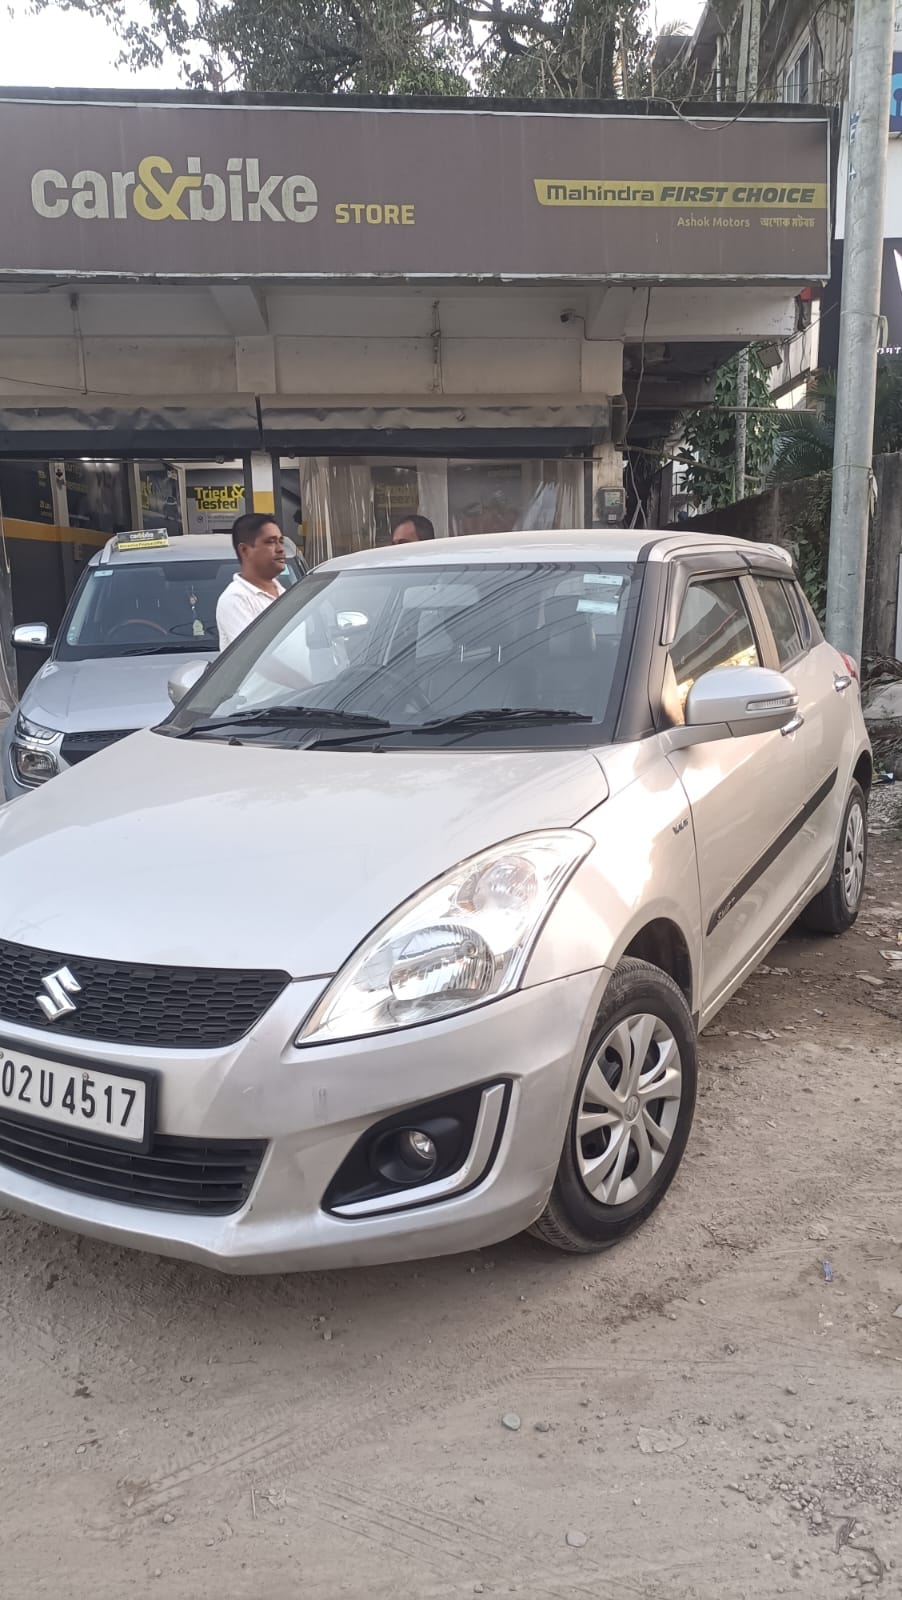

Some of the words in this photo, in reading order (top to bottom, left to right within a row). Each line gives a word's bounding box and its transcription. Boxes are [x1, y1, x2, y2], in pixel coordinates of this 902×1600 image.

[31, 155, 319, 223] car&bike
[335, 203, 416, 225] STORE
[546, 184, 655, 201] Mahindra
[660, 186, 729, 202] FIRST
[732, 186, 816, 203] CHOICE
[676, 212, 710, 228] Ashok
[712, 216, 751, 228] Motors
[196, 499, 238, 510] Tested
